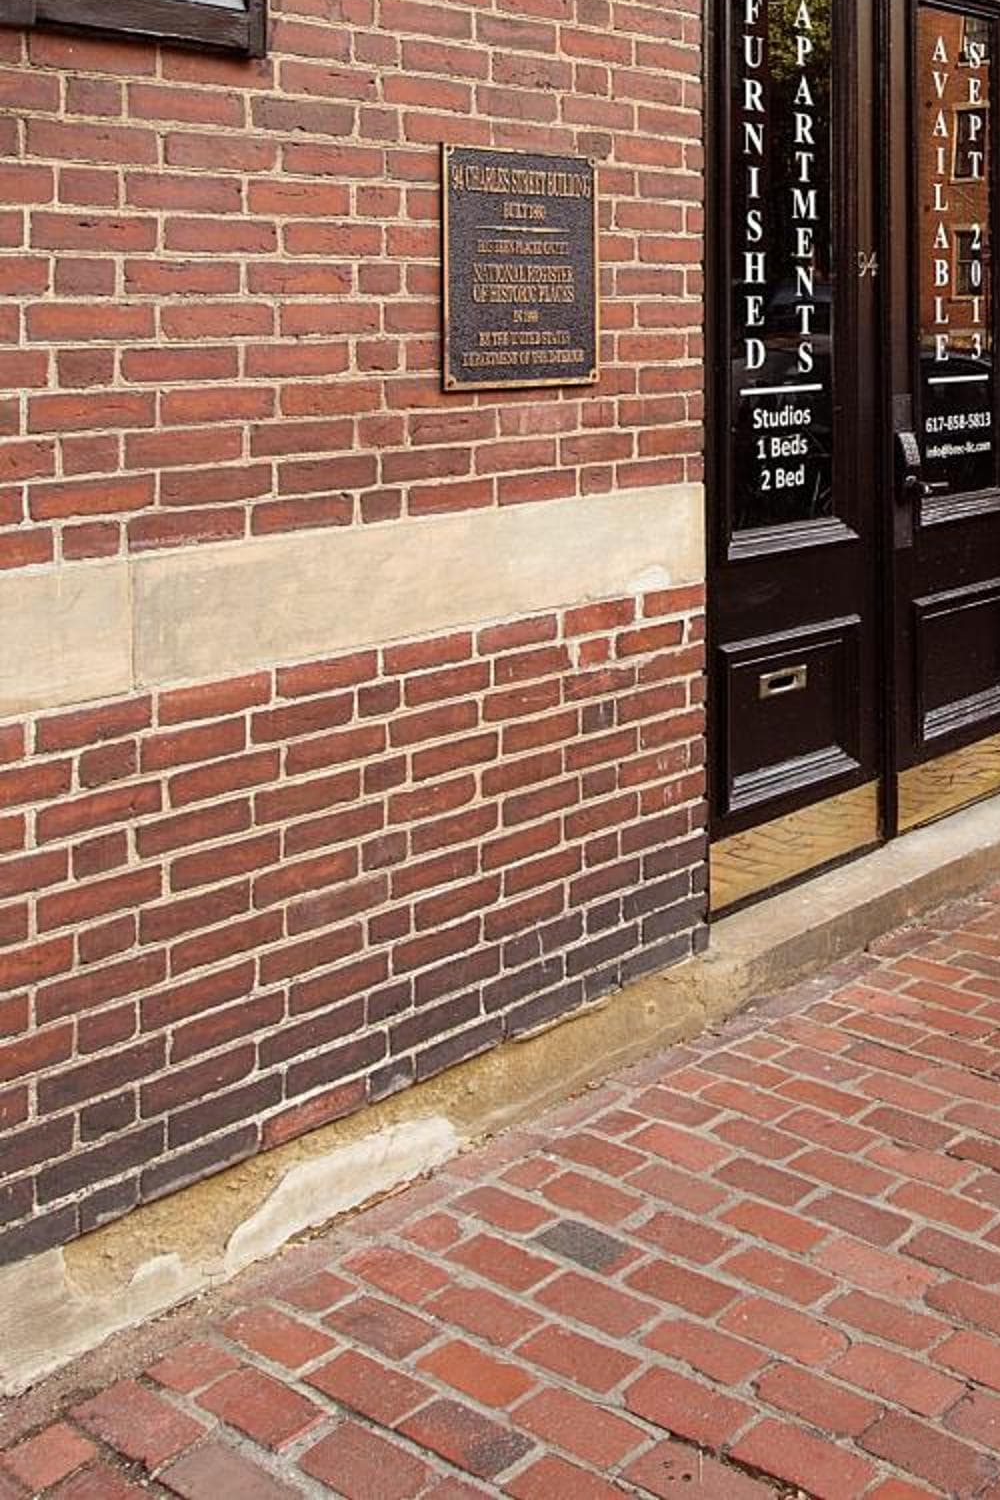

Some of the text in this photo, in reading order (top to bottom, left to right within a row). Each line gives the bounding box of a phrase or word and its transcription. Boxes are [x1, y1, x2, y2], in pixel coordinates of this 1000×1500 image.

[932, 35, 950, 362] AVAILABLE
[968, 40, 984, 361] SEPT 2013
[857, 251, 878, 277] 94
[752, 404, 812, 429] Studios
[756, 433, 808, 459] 1 Beds
[760, 463, 805, 491] 2 Bed
